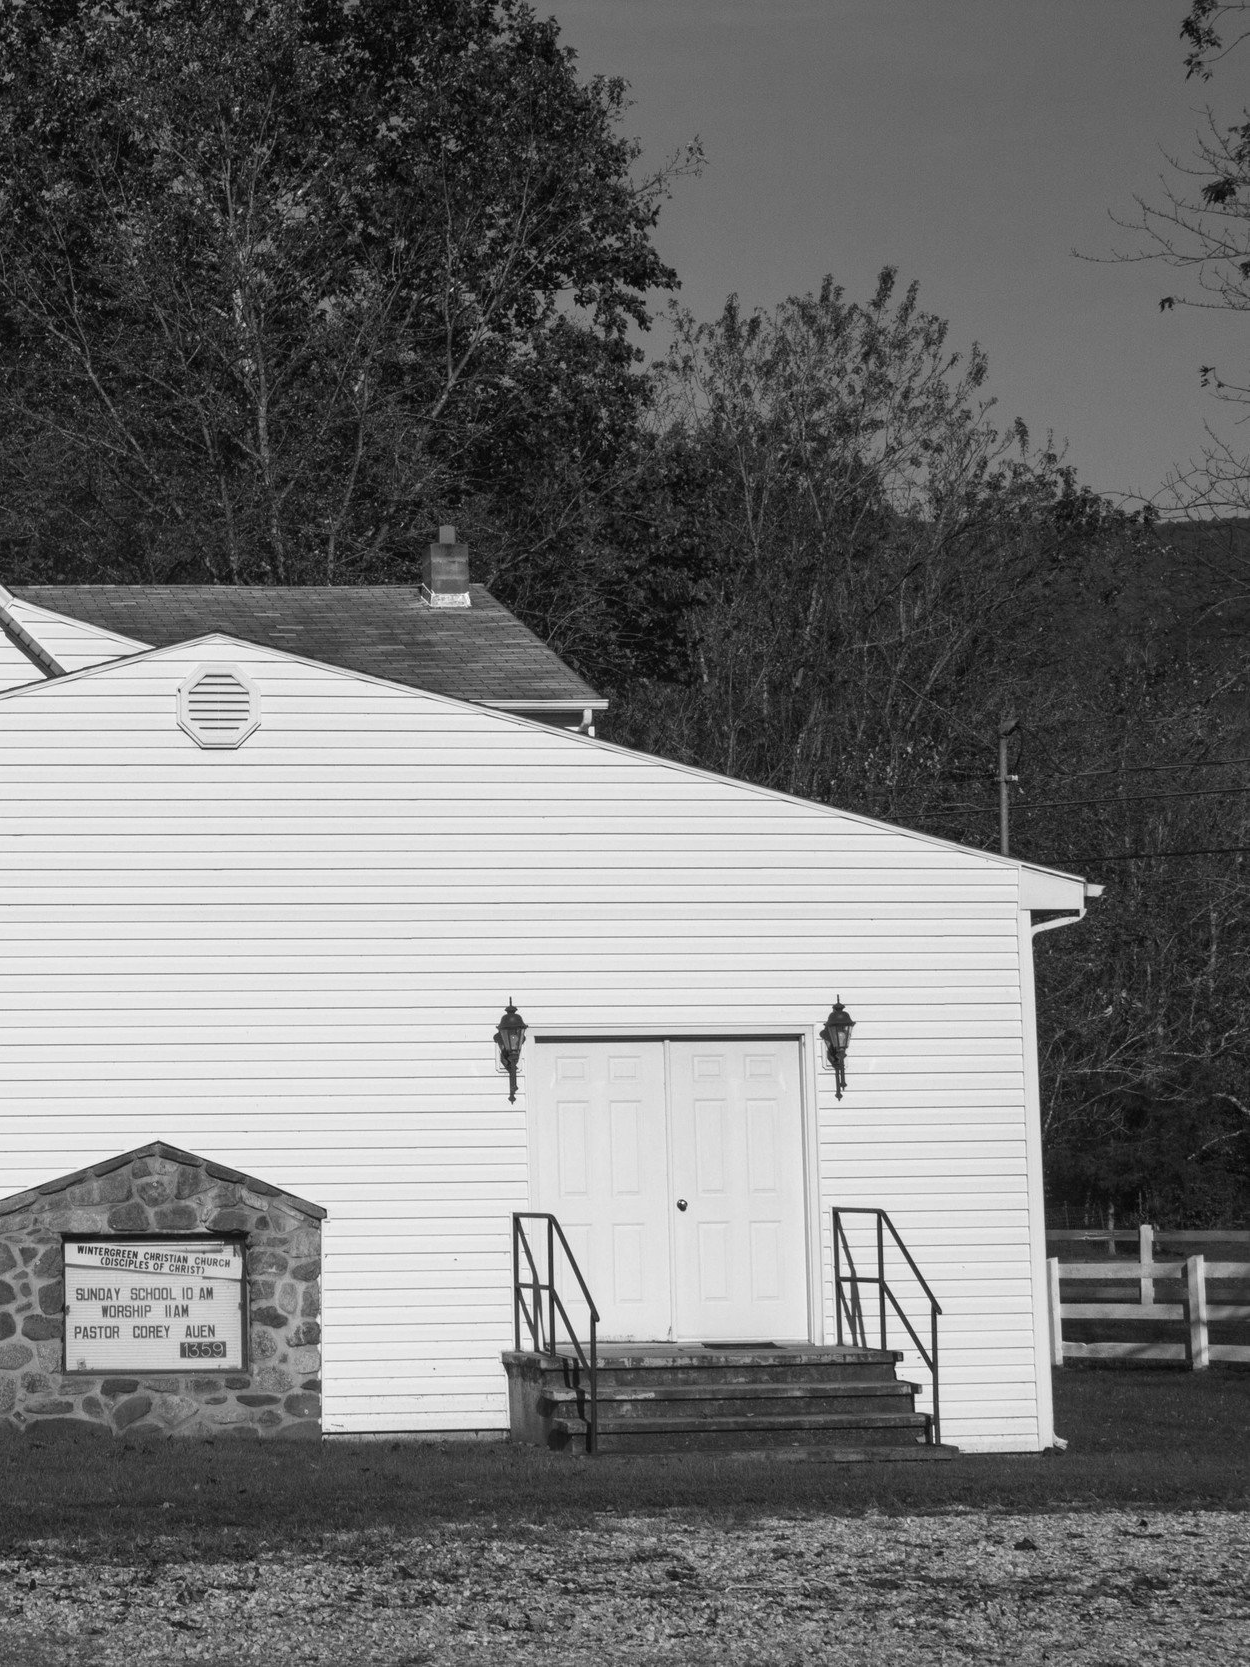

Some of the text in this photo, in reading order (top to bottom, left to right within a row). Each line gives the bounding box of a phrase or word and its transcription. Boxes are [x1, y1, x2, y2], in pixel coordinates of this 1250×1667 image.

[77, 1245, 231, 1268] WINTERGREEN CHRISTIAN CHURCH
[100, 1256, 205, 1275] (DISCIPLES OF CHRIST)
[75, 1286, 214, 1301] SUNDAY SCHOOL 10 AM
[101, 1304, 152, 1318] WORSHIP
[74, 1324, 216, 1339] PASTOR COREY AUEN
[183, 1342, 224, 1358] 1359
